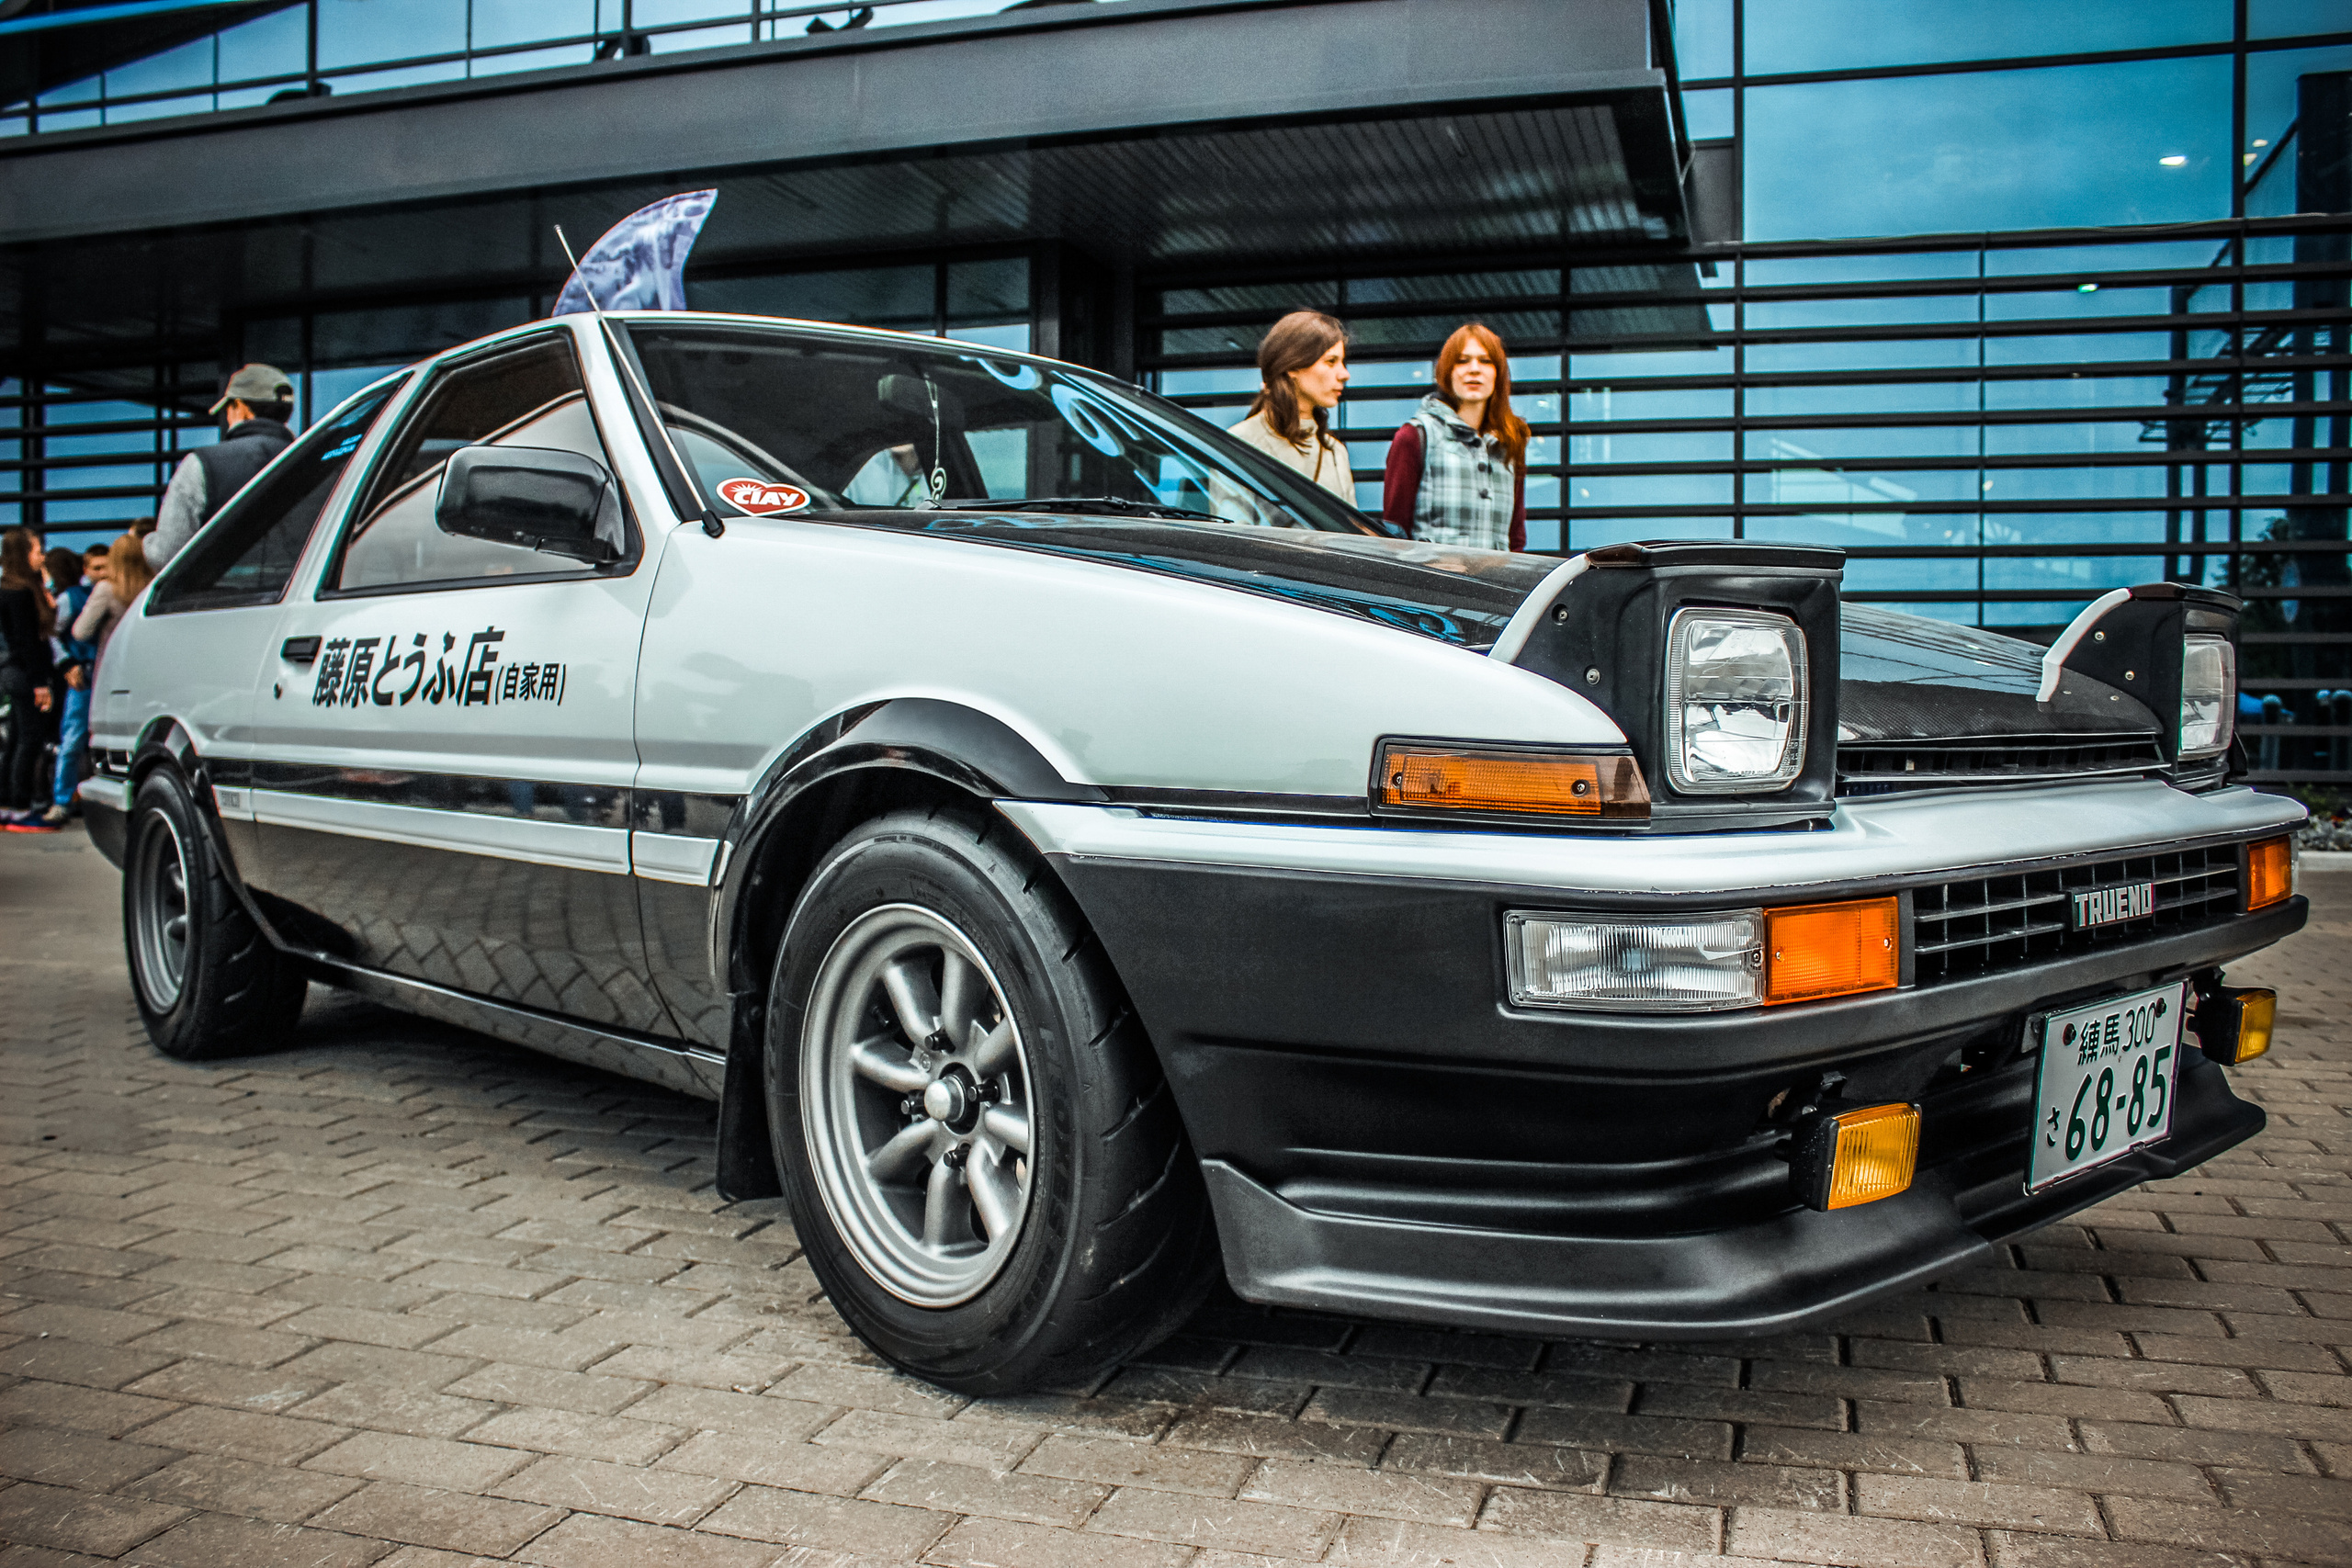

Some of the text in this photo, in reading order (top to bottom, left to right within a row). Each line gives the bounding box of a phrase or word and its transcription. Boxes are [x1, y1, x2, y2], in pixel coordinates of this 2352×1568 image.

[2075, 883, 2154, 927] TRUENO
[2076, 1001, 2156, 1066] 練馬 300
[2046, 1044, 2172, 1162] さ 68-85
